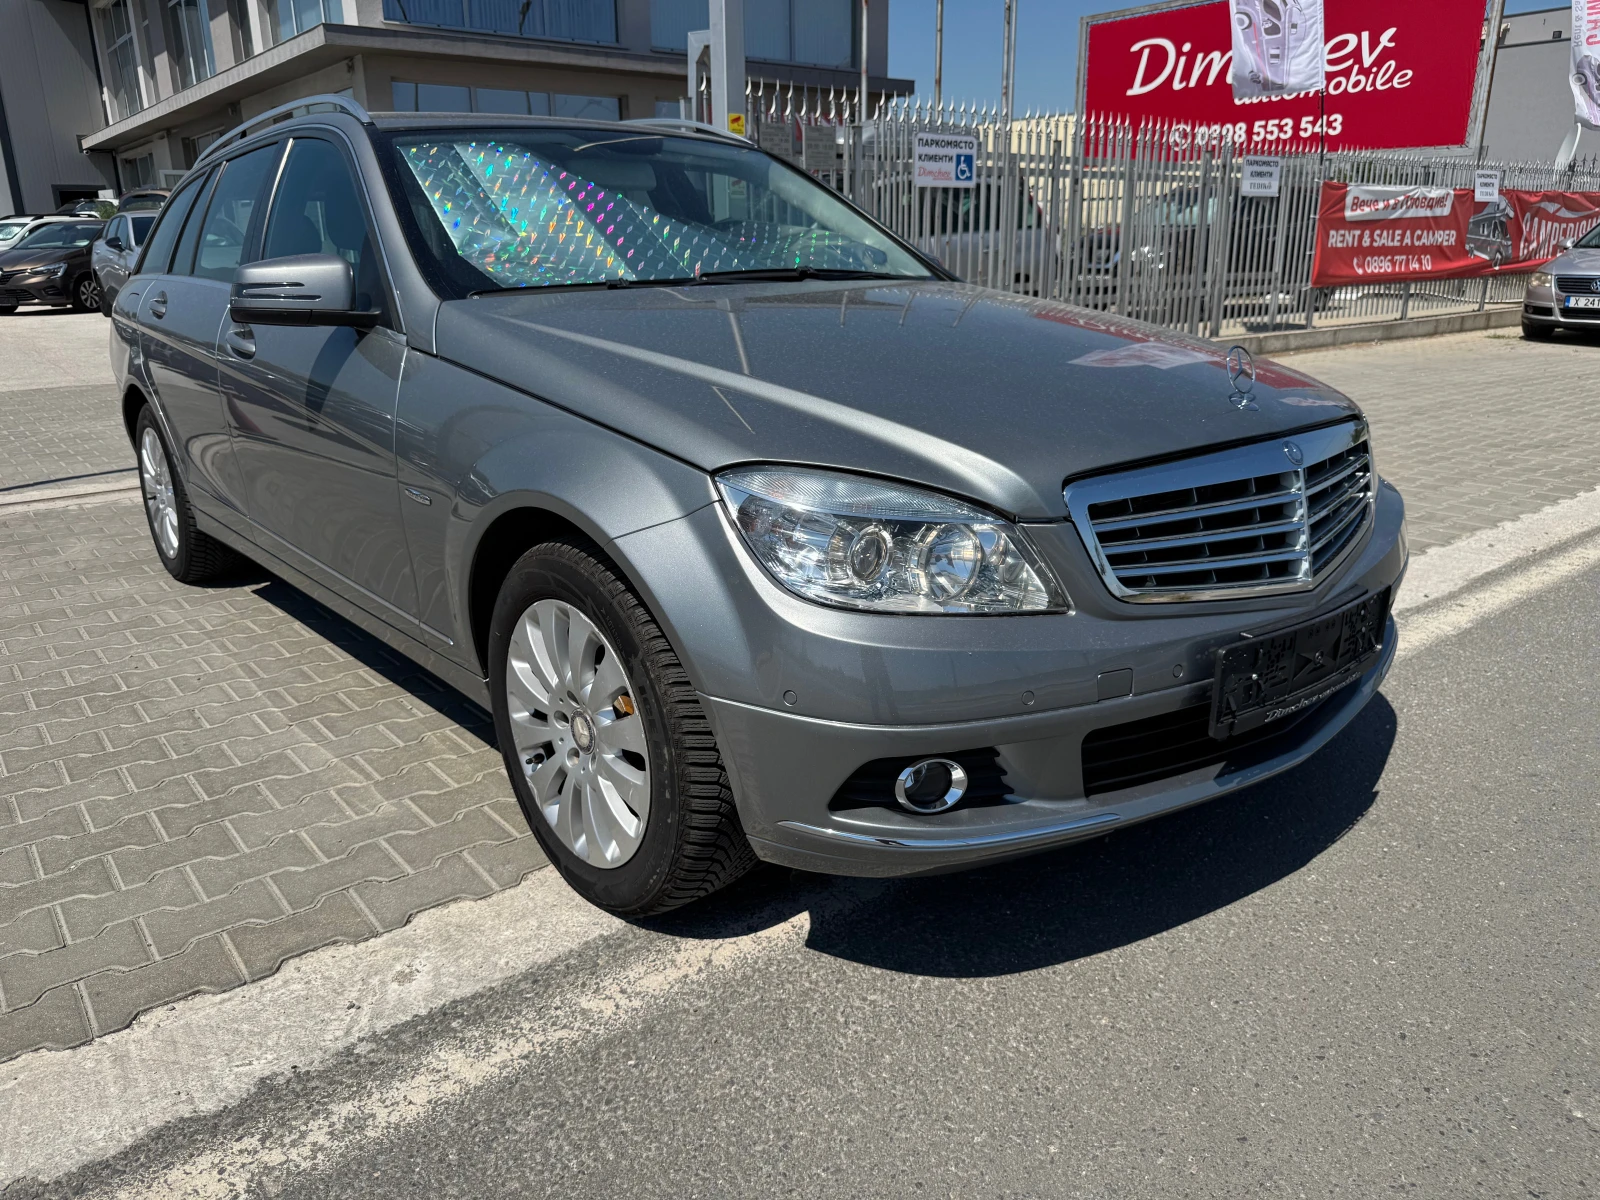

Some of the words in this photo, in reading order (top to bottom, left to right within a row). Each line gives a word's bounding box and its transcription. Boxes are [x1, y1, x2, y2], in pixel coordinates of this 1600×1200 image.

[1126, 27, 1397, 96] Dimev
[1233, 60, 1413, 106] obile
[1252, 118, 1293, 141] 553
[1299, 113, 1342, 137] 543
[918, 138, 974, 150] ПАРКОМЯСТО
[918, 154, 953, 163] КЛИЕНТИ
[1350, 196, 1379, 212] Вече
[1327, 230, 1361, 248] RENT
[1362, 230, 1371, 247] &
[1372, 230, 1402, 247] SALE
[1402, 230, 1411, 246] A
[1413, 230, 1457, 246] CAMPER
[1364, 256, 1392, 273] 0896
[1394, 255, 1406, 272] 77
[1408, 255, 1419, 271] 14
[1421, 254, 1432, 271] 10
